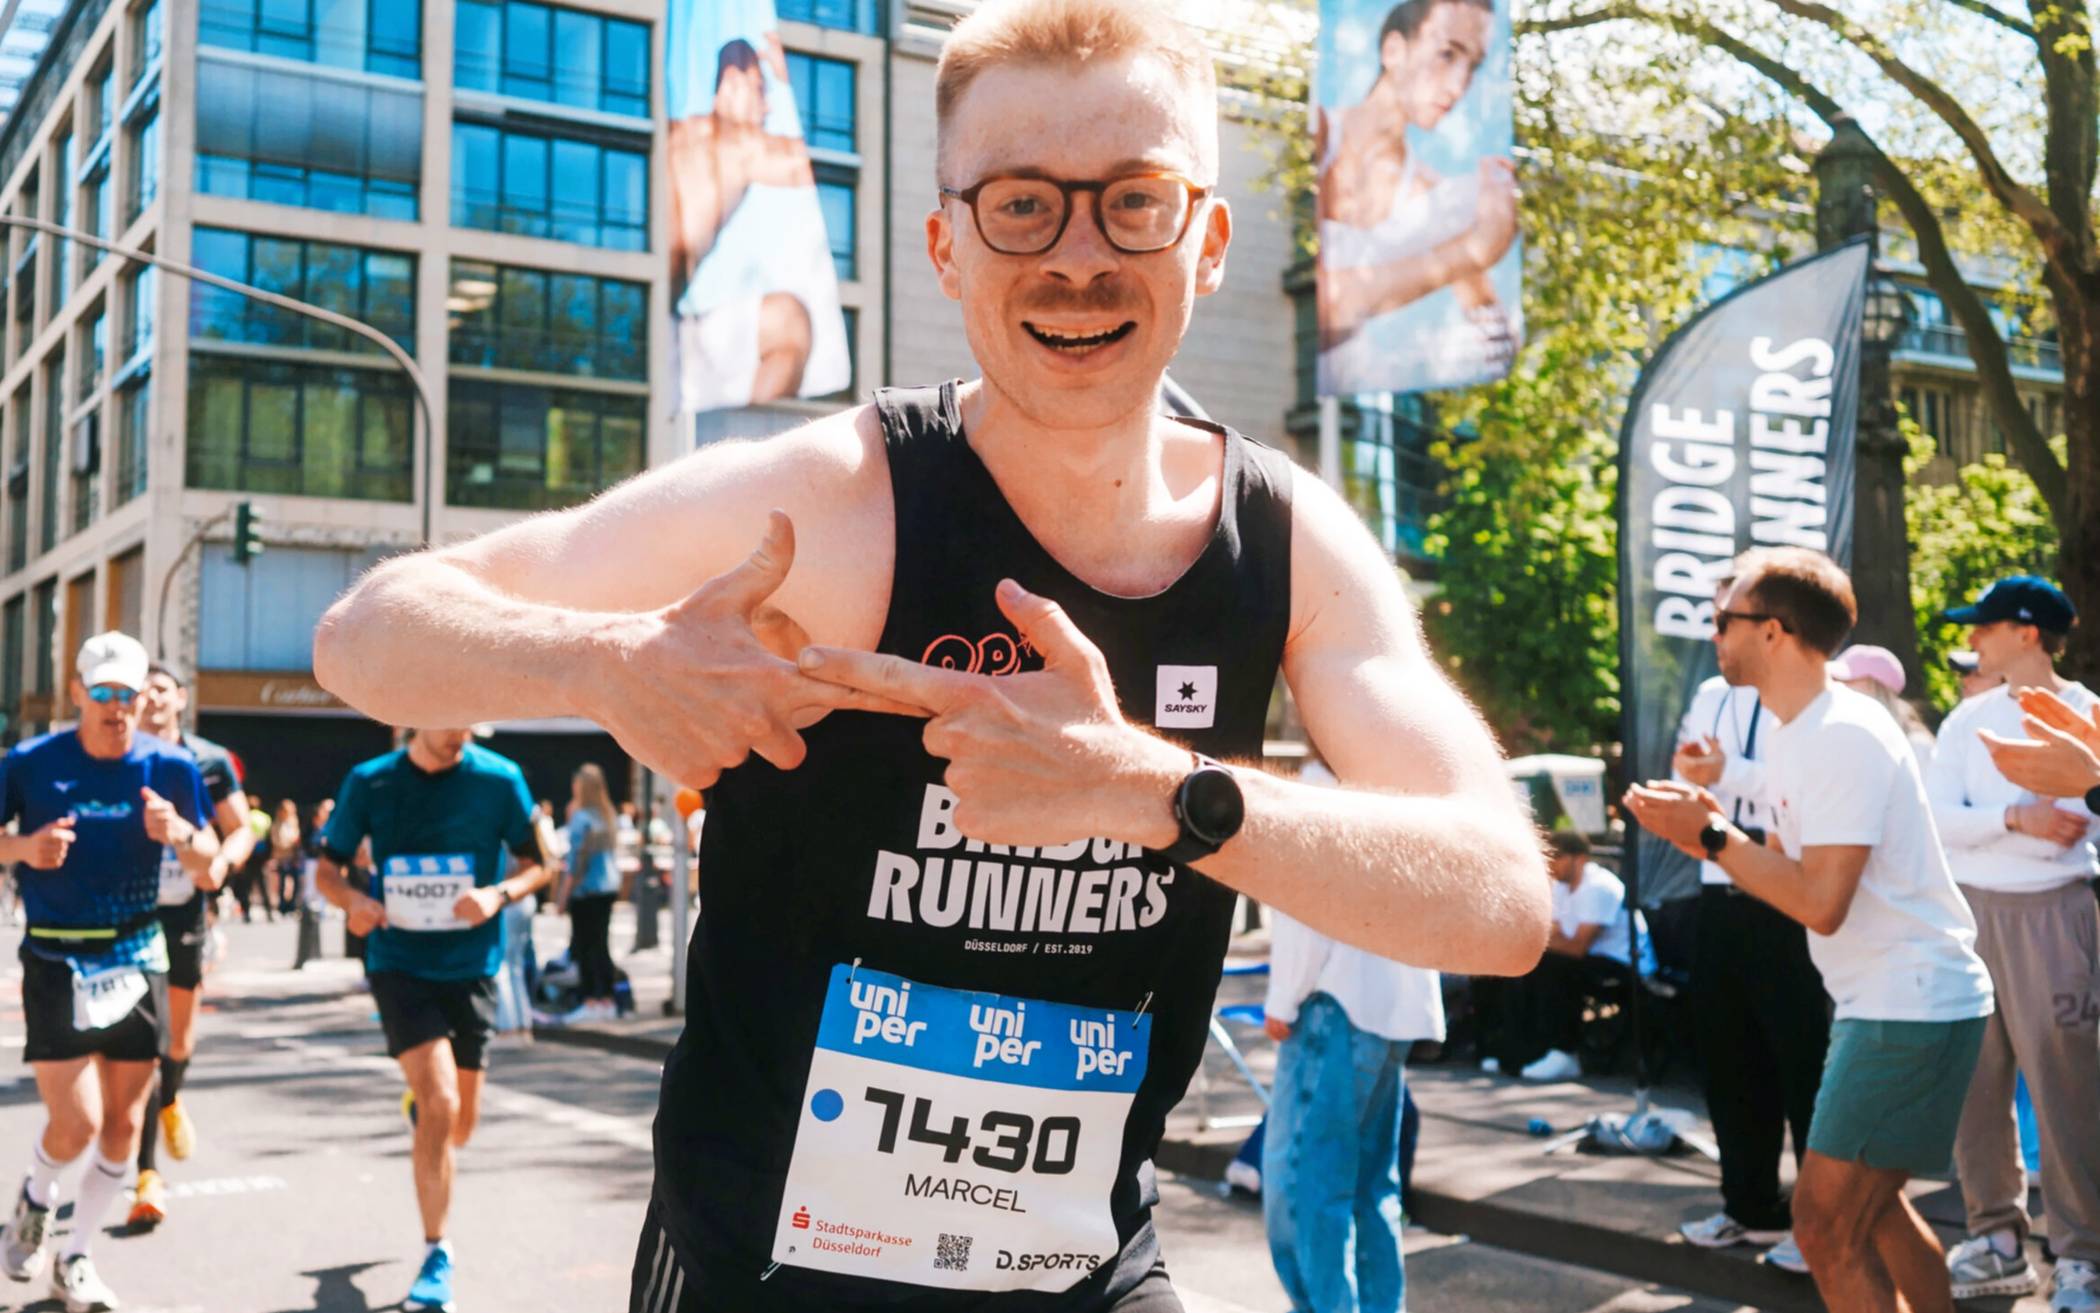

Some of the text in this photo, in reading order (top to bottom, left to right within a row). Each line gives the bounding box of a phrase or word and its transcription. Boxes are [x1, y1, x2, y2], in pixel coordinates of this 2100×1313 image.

[1750, 336, 1834, 550] NNERS
[1651, 403, 1736, 641] BRIDGE
[1164, 703, 1208, 714] SAYSKY
[866, 850, 1175, 933] RUNNERS
[964, 938, 1028, 953] DÜSSELDORF
[1044, 943, 1093, 955] EST.2019
[850, 981, 911, 1018] uni
[853, 1010, 927, 1047] per
[969, 1002, 1025, 1037] uni
[1070, 1013, 1115, 1048] uni
[973, 1033, 1041, 1068] per
[1075, 1047, 1133, 1081] per
[904, 1173, 1027, 1214] MARCEL
[812, 1237, 882, 1258] Düsseldorf
[815, 1219, 913, 1247] Stadtsparkasse
[996, 1249, 1100, 1271] D.SPORTS
